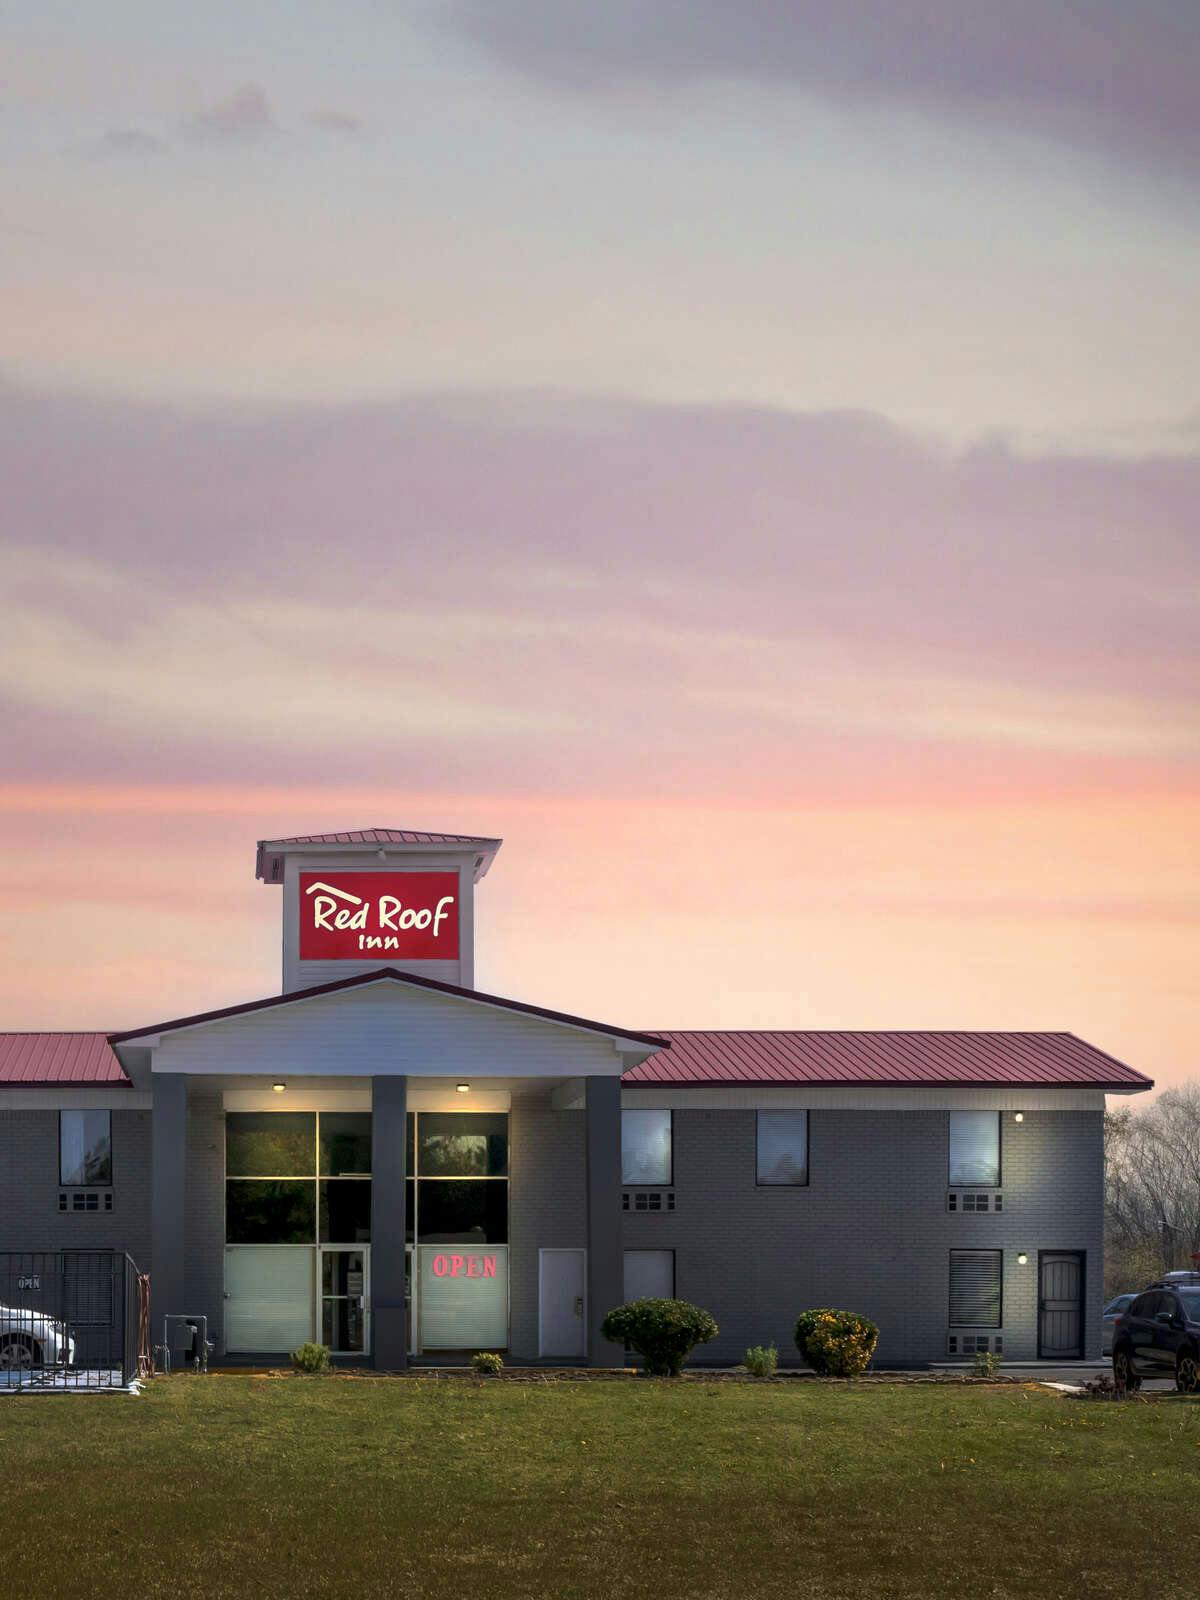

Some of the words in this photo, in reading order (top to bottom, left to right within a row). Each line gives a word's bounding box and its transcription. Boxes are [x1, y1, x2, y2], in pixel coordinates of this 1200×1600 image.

[314, 895, 370, 931] Red
[379, 895, 454, 937] Roof
[433, 1254, 497, 1278] OPEN
